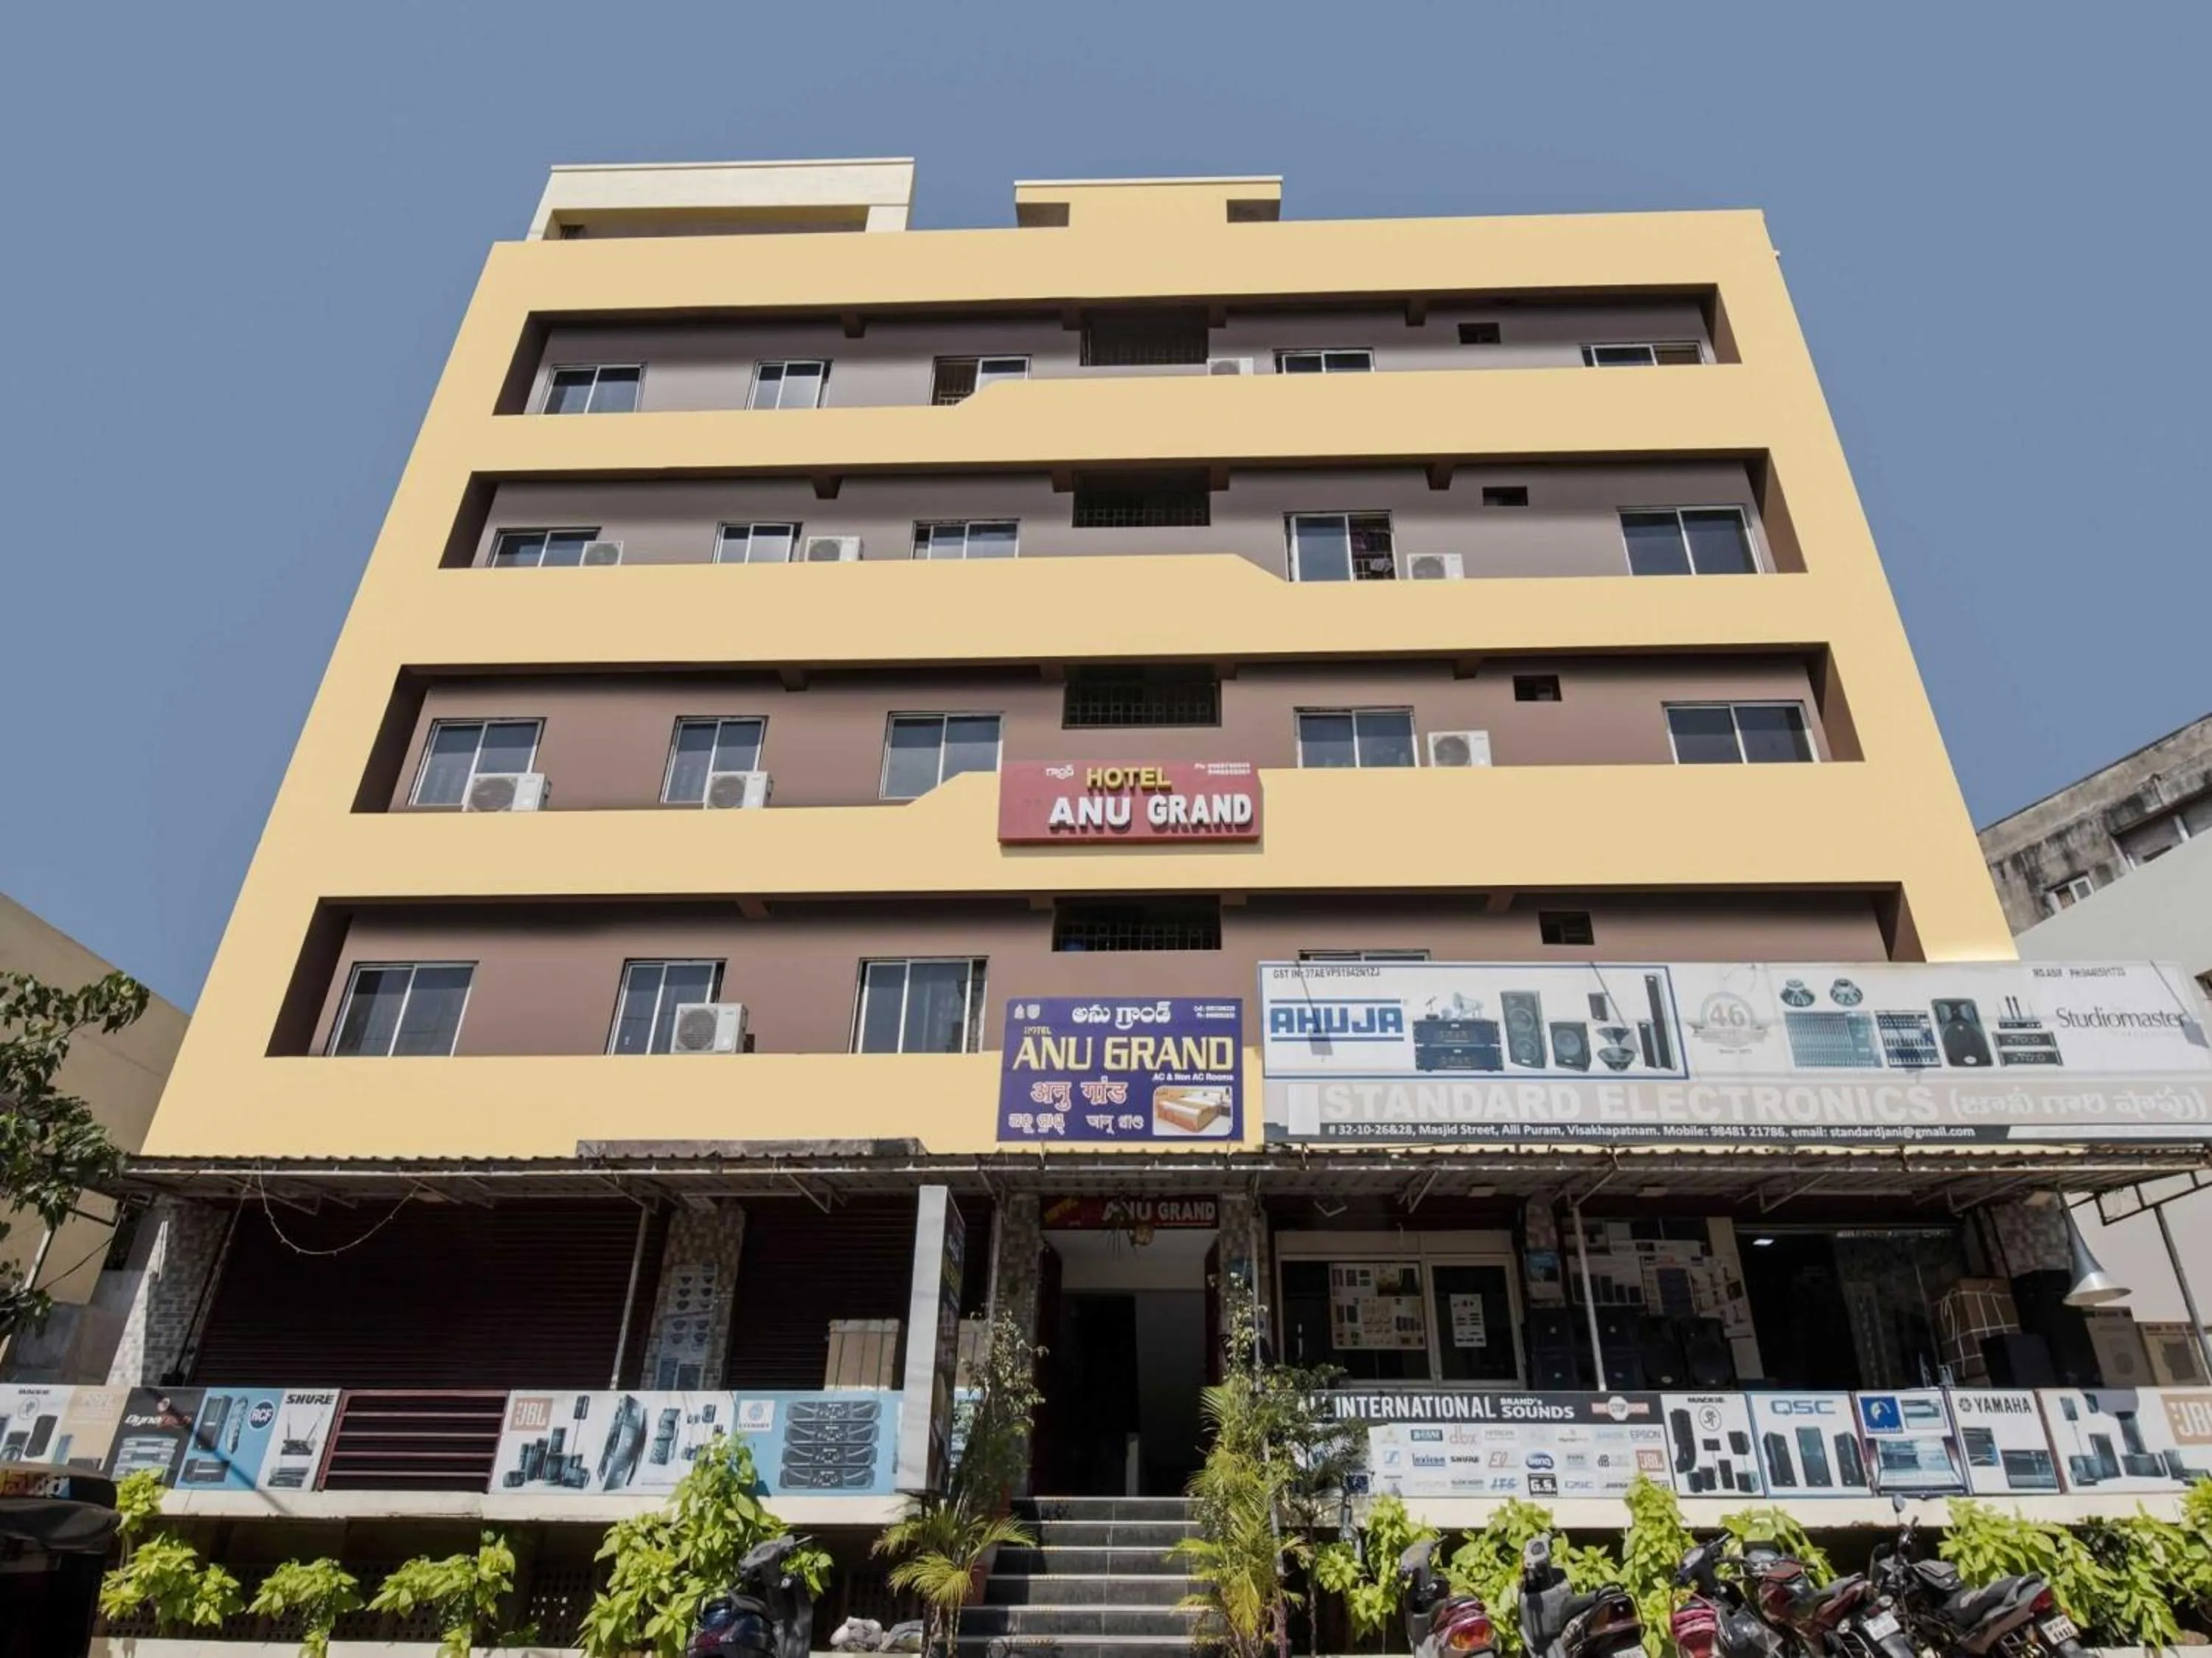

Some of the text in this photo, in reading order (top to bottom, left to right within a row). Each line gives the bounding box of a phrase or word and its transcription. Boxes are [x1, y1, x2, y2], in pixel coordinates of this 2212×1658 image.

[1086, 767, 1172, 788] HOTEL
[1049, 794, 1252, 826] ANU GRAND
[1072, 1004, 1111, 1024] అను
[1115, 1001, 1172, 1030] గ్రాండ్
[1270, 1007, 1404, 1033] AHUJA
[1710, 1002, 1746, 1027] 46
[2056, 1006, 2185, 1028] Studiomaster
[1023, 1026, 1052, 1036] HOTEL
[1012, 1036, 1234, 1072] ANU GRAND
[1152, 1072, 1234, 1081] AC & Non AC Rooms
[1031, 1081, 1072, 1111] अनु
[1324, 1084, 1940, 1121] STANDARD ELECTRONICS
[1329, 1125, 1335, 1134] #
[1338, 1124, 1416, 1137] 32-10-26&28,
[1419, 1124, 1457, 1137] Masjid
[1460, 1125, 1499, 1137] Street,
[1663, 1125, 1708, 1137] Mobile:
[1710, 1125, 1747, 1137] 98481
[1791, 1126, 1827, 1137] email:
[1830, 1125, 1976, 1140] standardjani@gmail.com
[1158, 1201, 1216, 1220] GRAND
[286, 1393, 335, 1405] SHURE
[1335, 1395, 1496, 1418] INTERNATIONAL
[1771, 1400, 1836, 1415] QSC
[1973, 1397, 2032, 1414] YAMAHA
[251, 1408, 272, 1422] RCF
[515, 1401, 546, 1426] JBL
[1501, 1405, 1575, 1418] SOUNDS
[1630, 1429, 1661, 1439] EPSON
[1450, 1455, 1480, 1463] SHURE
[1638, 1451, 1663, 1469] JBL
